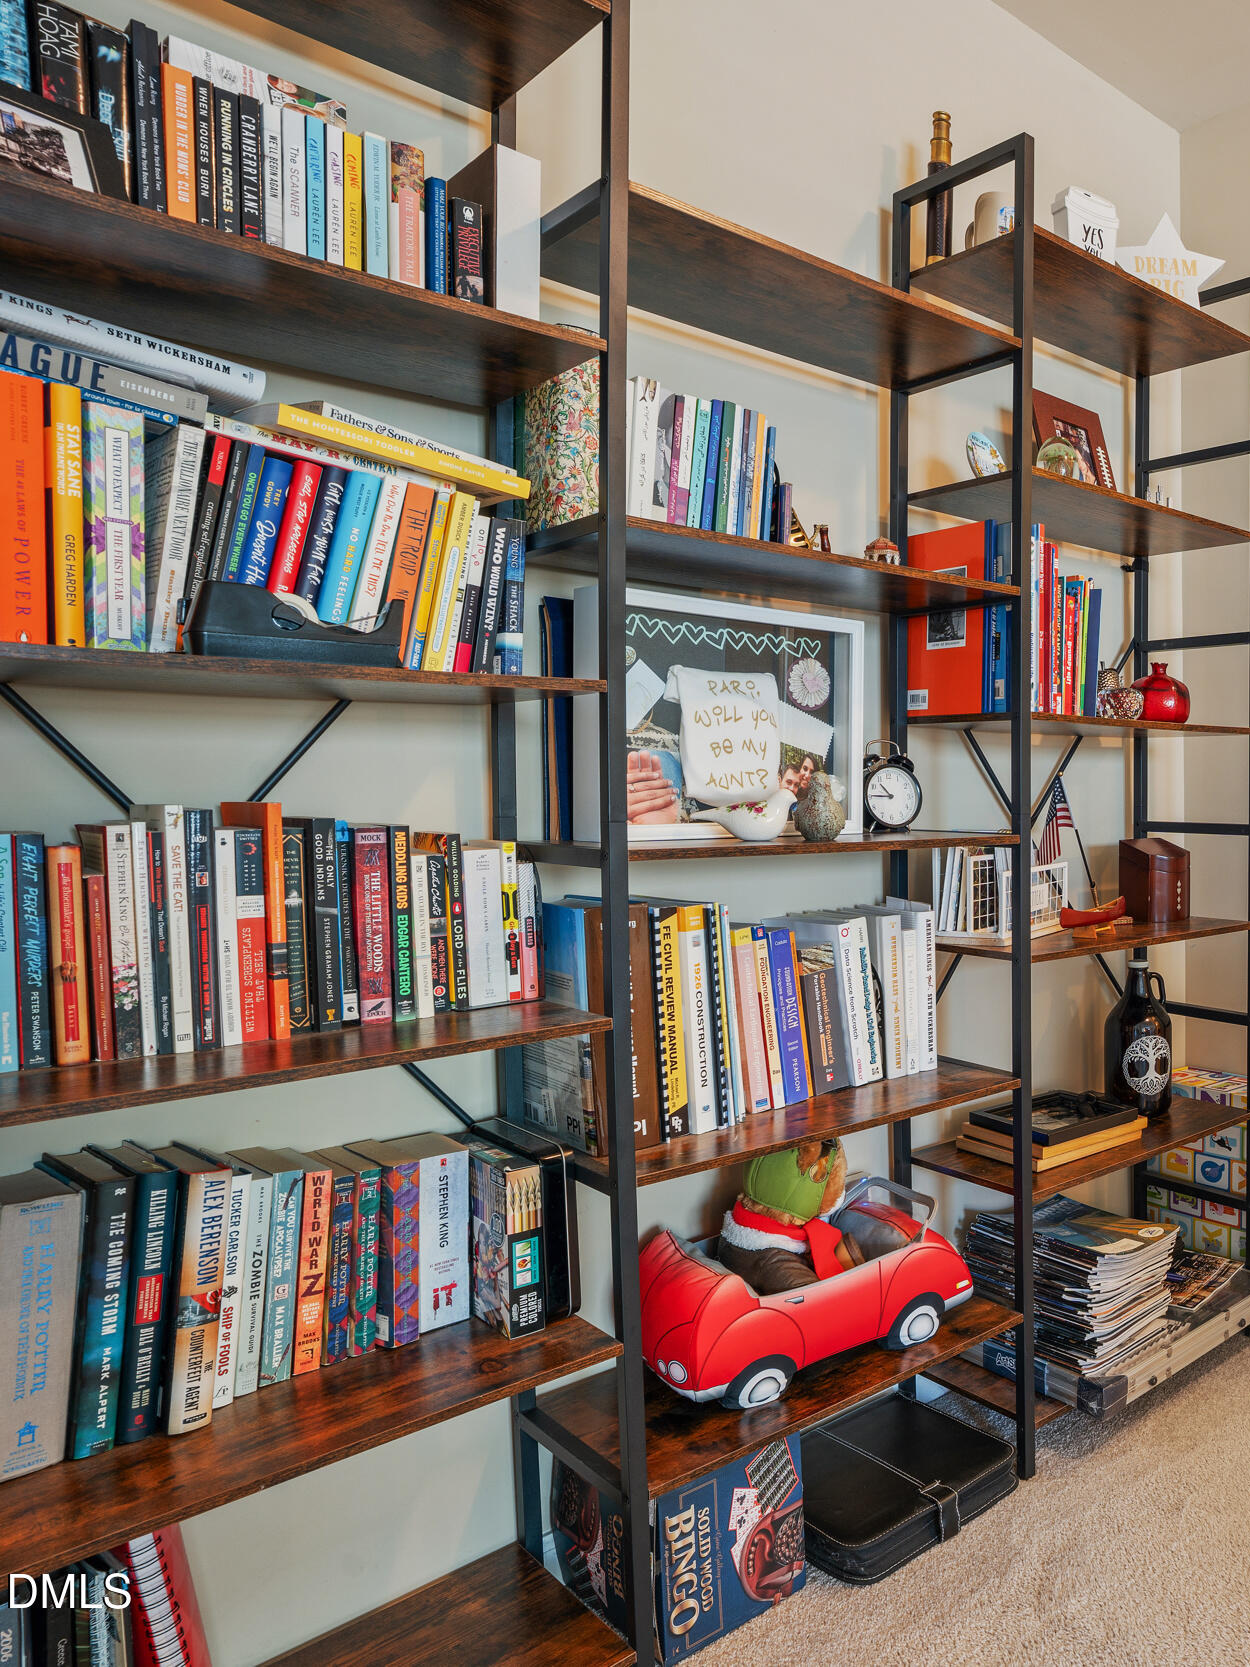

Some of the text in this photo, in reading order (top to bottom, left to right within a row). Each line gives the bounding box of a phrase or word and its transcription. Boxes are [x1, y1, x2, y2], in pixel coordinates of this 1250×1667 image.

[37, 4, 59, 58] HOAG
[59, 21, 80, 59] TAMI
[174, 82, 190, 203] MURDER CLUB
[199, 87, 209, 197] WHEN HOUSES BURN
[220, 100, 233, 212] RUNNING IN CIRCLES
[241, 115, 258, 215] CRANBERRY LANE
[309, 138, 322, 182] CAPTURING
[346, 154, 360, 189] COMING
[269, 157, 278, 198] BEGIN AGAIN
[290, 147, 299, 217] The SCANNER
[458, 225, 470, 270] PRIVILEGE
[468, 227, 480, 275] EXECUTIVE
[1082, 223, 1104, 250] YES
[1134, 255, 1197, 278] DREAM
[8, 294, 54, 316] KINGS
[107, 327, 231, 375] SETH WICKERSHAM
[66, 424, 80, 497] STAY SANE
[290, 414, 415, 457] THE MONTESSORI TODDLER
[330, 408, 414, 446] Fathers Sons
[113, 436, 123, 512] WHAT TO EXPECT
[168, 441, 199, 561] THE MILLIONAIRE NEXT DOOR
[263, 481, 274, 508] GOWDY
[273, 488, 282, 507] TREY
[228, 472, 256, 572] ONCE YOU GO EVERYWHERE
[296, 500, 308, 523] STOP
[13, 537, 31, 616] POWER
[65, 534, 77, 607] GREG HARDEN
[114, 529, 124, 601] THE FIRST YEAR
[330, 527, 360, 622] NO HARD FEELINGS
[484, 527, 506, 631] WHO WOULD WIN?
[509, 600, 519, 632] SHACK
[706, 769, 768, 790] AUNT?
[171, 845, 182, 889] SAVE THE
[314, 833, 325, 901] GOOD INDIANS
[360, 834, 381, 842] MOCK
[395, 831, 408, 909] MEDDLING KIDS
[117, 853, 129, 921] STEPHEN KING
[326, 865, 334, 888] ONLY
[21, 843, 42, 987] EIGHT PERFECT MURDERS
[371, 871, 383, 973] THE LITTLE WOODS
[242, 927, 255, 1033] WRITING SCREENPLAYS
[255, 950, 264, 1003] THAT SELL
[323, 917, 334, 1003] STEPHEN GRAHAM JONES
[398, 915, 411, 995] EDGAR CANTERO
[453, 920, 466, 999] LORD FLIES
[30, 991, 41, 1050] PETER SWANSON
[662, 925, 678, 1074] FE CIVIL REVIEW MANUAL
[693, 962, 708, 1088] 1926 CONSTRUCTION
[786, 998, 798, 1028] DESIGN
[819, 972, 835, 1064] Geotechnical Engineer's
[792, 1058, 801, 1091] PEARSON
[144, 1189, 168, 1270] KILLING LINCOLN
[196, 1180, 226, 1286] ALEX BERENSON
[226, 1189, 243, 1276] TUCKER CARLSON
[308, 1176, 325, 1231] WORLD
[439, 1176, 449, 1248] STEPHEN KING
[101, 1212, 126, 1336] THE COMING STORM
[249, 1250, 263, 1301] ZOMBIE
[273, 1226, 284, 1278] APOCALYPSE?
[300, 1272, 324, 1298] Z
[308, 1236, 323, 1270] WAR
[338, 1221, 349, 1306] HARRY POTTER
[365, 1215, 375, 1298] HARRY POTTER
[30, 1243, 55, 1395] HARRY POTTER
[217, 1306, 233, 1376] SHIP OF FOOLS
[274, 1306, 284, 1326] MAX
[519, 1295, 528, 1327] PREMIUM
[529, 1291, 537, 1324] COLORED
[97, 1347, 112, 1429] MARK ALPERT
[135, 1327, 154, 1384] BILL O'REILLY
[184, 1329, 205, 1412] COUNTERFEIT AGENT
[204, 1360, 214, 1373] THE
[664, 1504, 699, 1636] BINGO
[697, 1507, 714, 1612] SOLID WOOD
